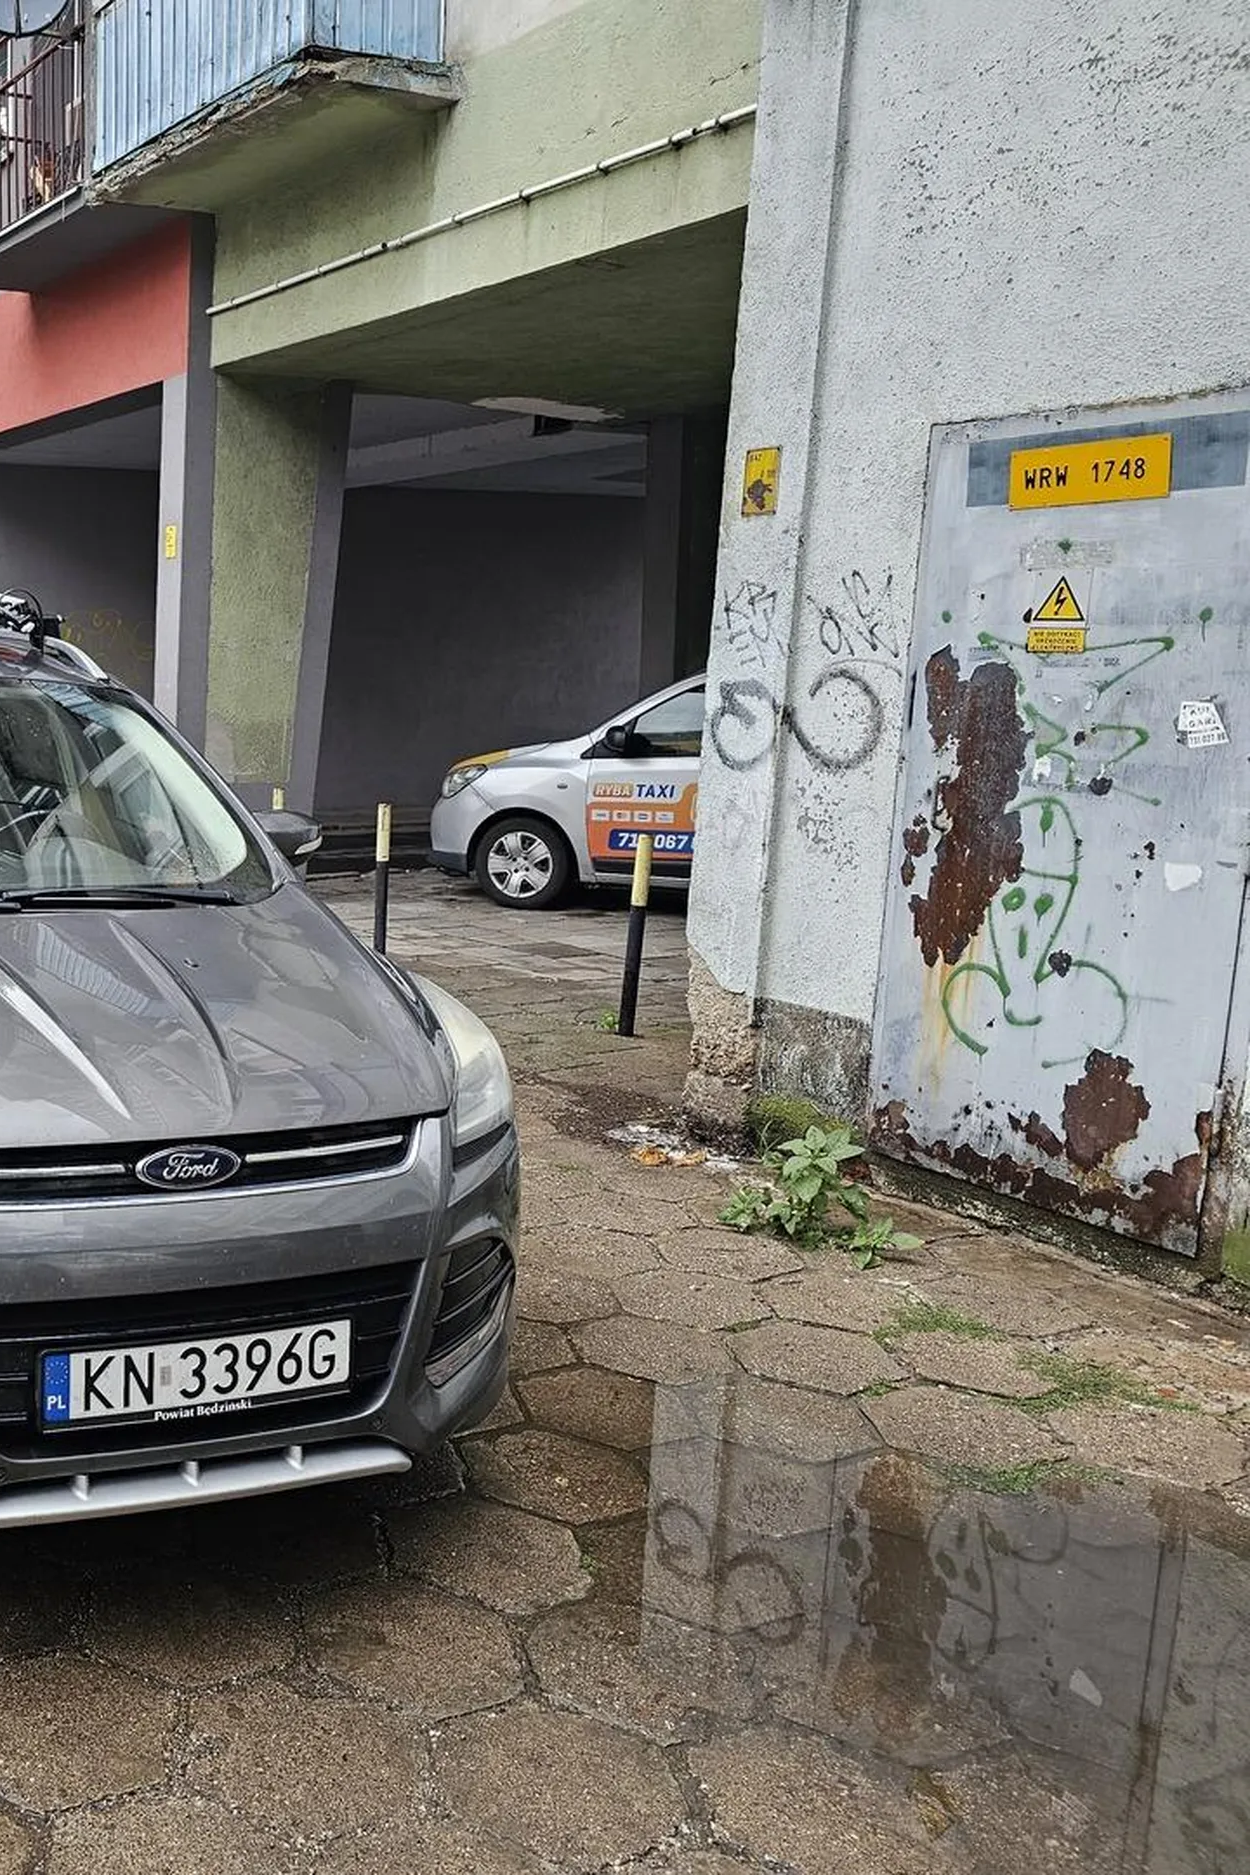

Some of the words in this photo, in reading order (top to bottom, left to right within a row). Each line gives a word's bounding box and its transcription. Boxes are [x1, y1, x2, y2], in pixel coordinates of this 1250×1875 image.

[1024, 465, 1068, 490] WRW
[1092, 457, 1145, 483] 1748
[595, 783, 632, 797] RYBA
[636, 784, 675, 798] TAXI
[653, 834, 689, 849] 067
[162, 1152, 220, 1180] Ford
[83, 1352, 155, 1412] KN
[179, 1328, 337, 1399] 3396G
[46, 1395, 67, 1411] PL
[154, 1406, 195, 1422] Powiat
[196, 1399, 253, 1417] Będziński
